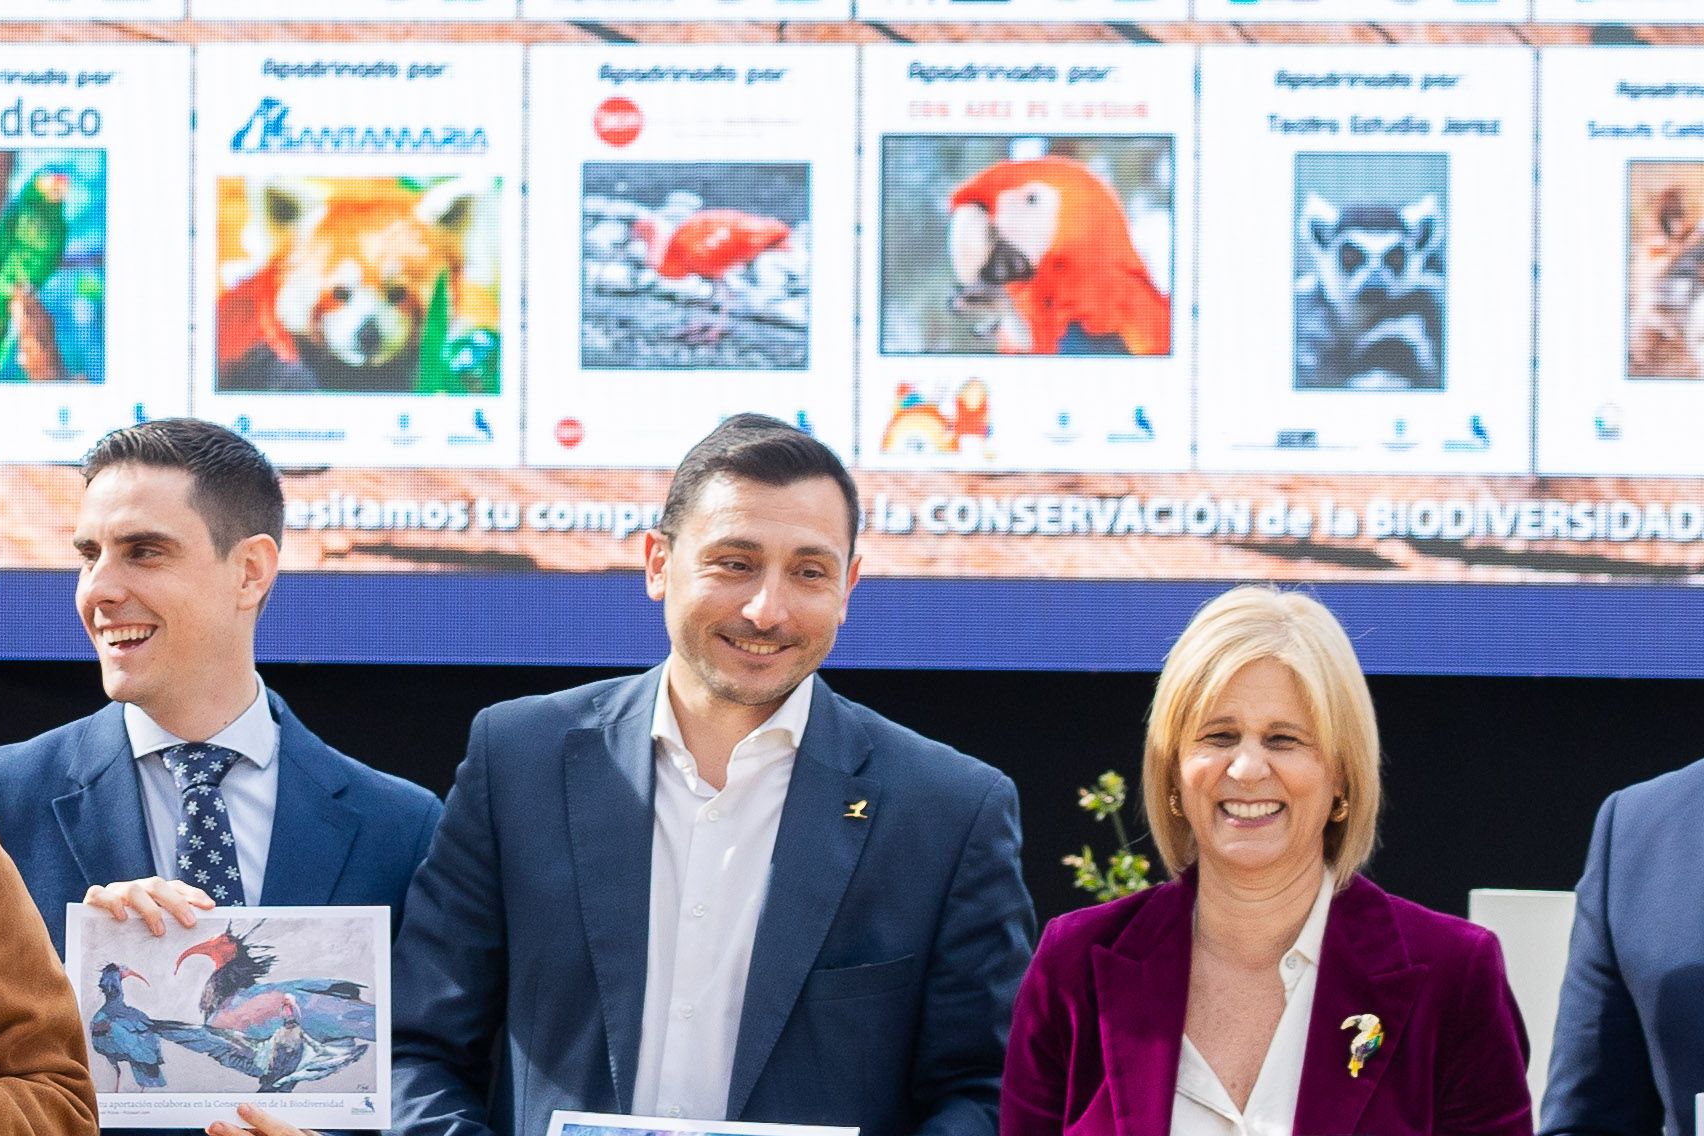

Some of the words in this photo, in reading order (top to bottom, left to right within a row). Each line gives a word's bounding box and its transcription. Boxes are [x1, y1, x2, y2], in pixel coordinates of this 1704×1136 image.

[260, 57, 401, 80] Apadrinado
[597, 62, 739, 86] Apadrinado
[906, 60, 1060, 85] Apadrinado
[1273, 68, 1414, 92] Apadrinado
[1266, 112, 1342, 136] Teatro
[1348, 114, 1433, 136] Estudio
[1441, 116, 1502, 137] Jerez
[477, 498, 520, 531] tu
[527, 502, 663, 540] compr
[874, 494, 914, 534] la
[920, 494, 1252, 536] CONSERVACIÓN
[1257, 498, 1313, 538] de
[1319, 499, 1360, 538] la
[1367, 499, 1704, 542] BIODIVERSIDAD
